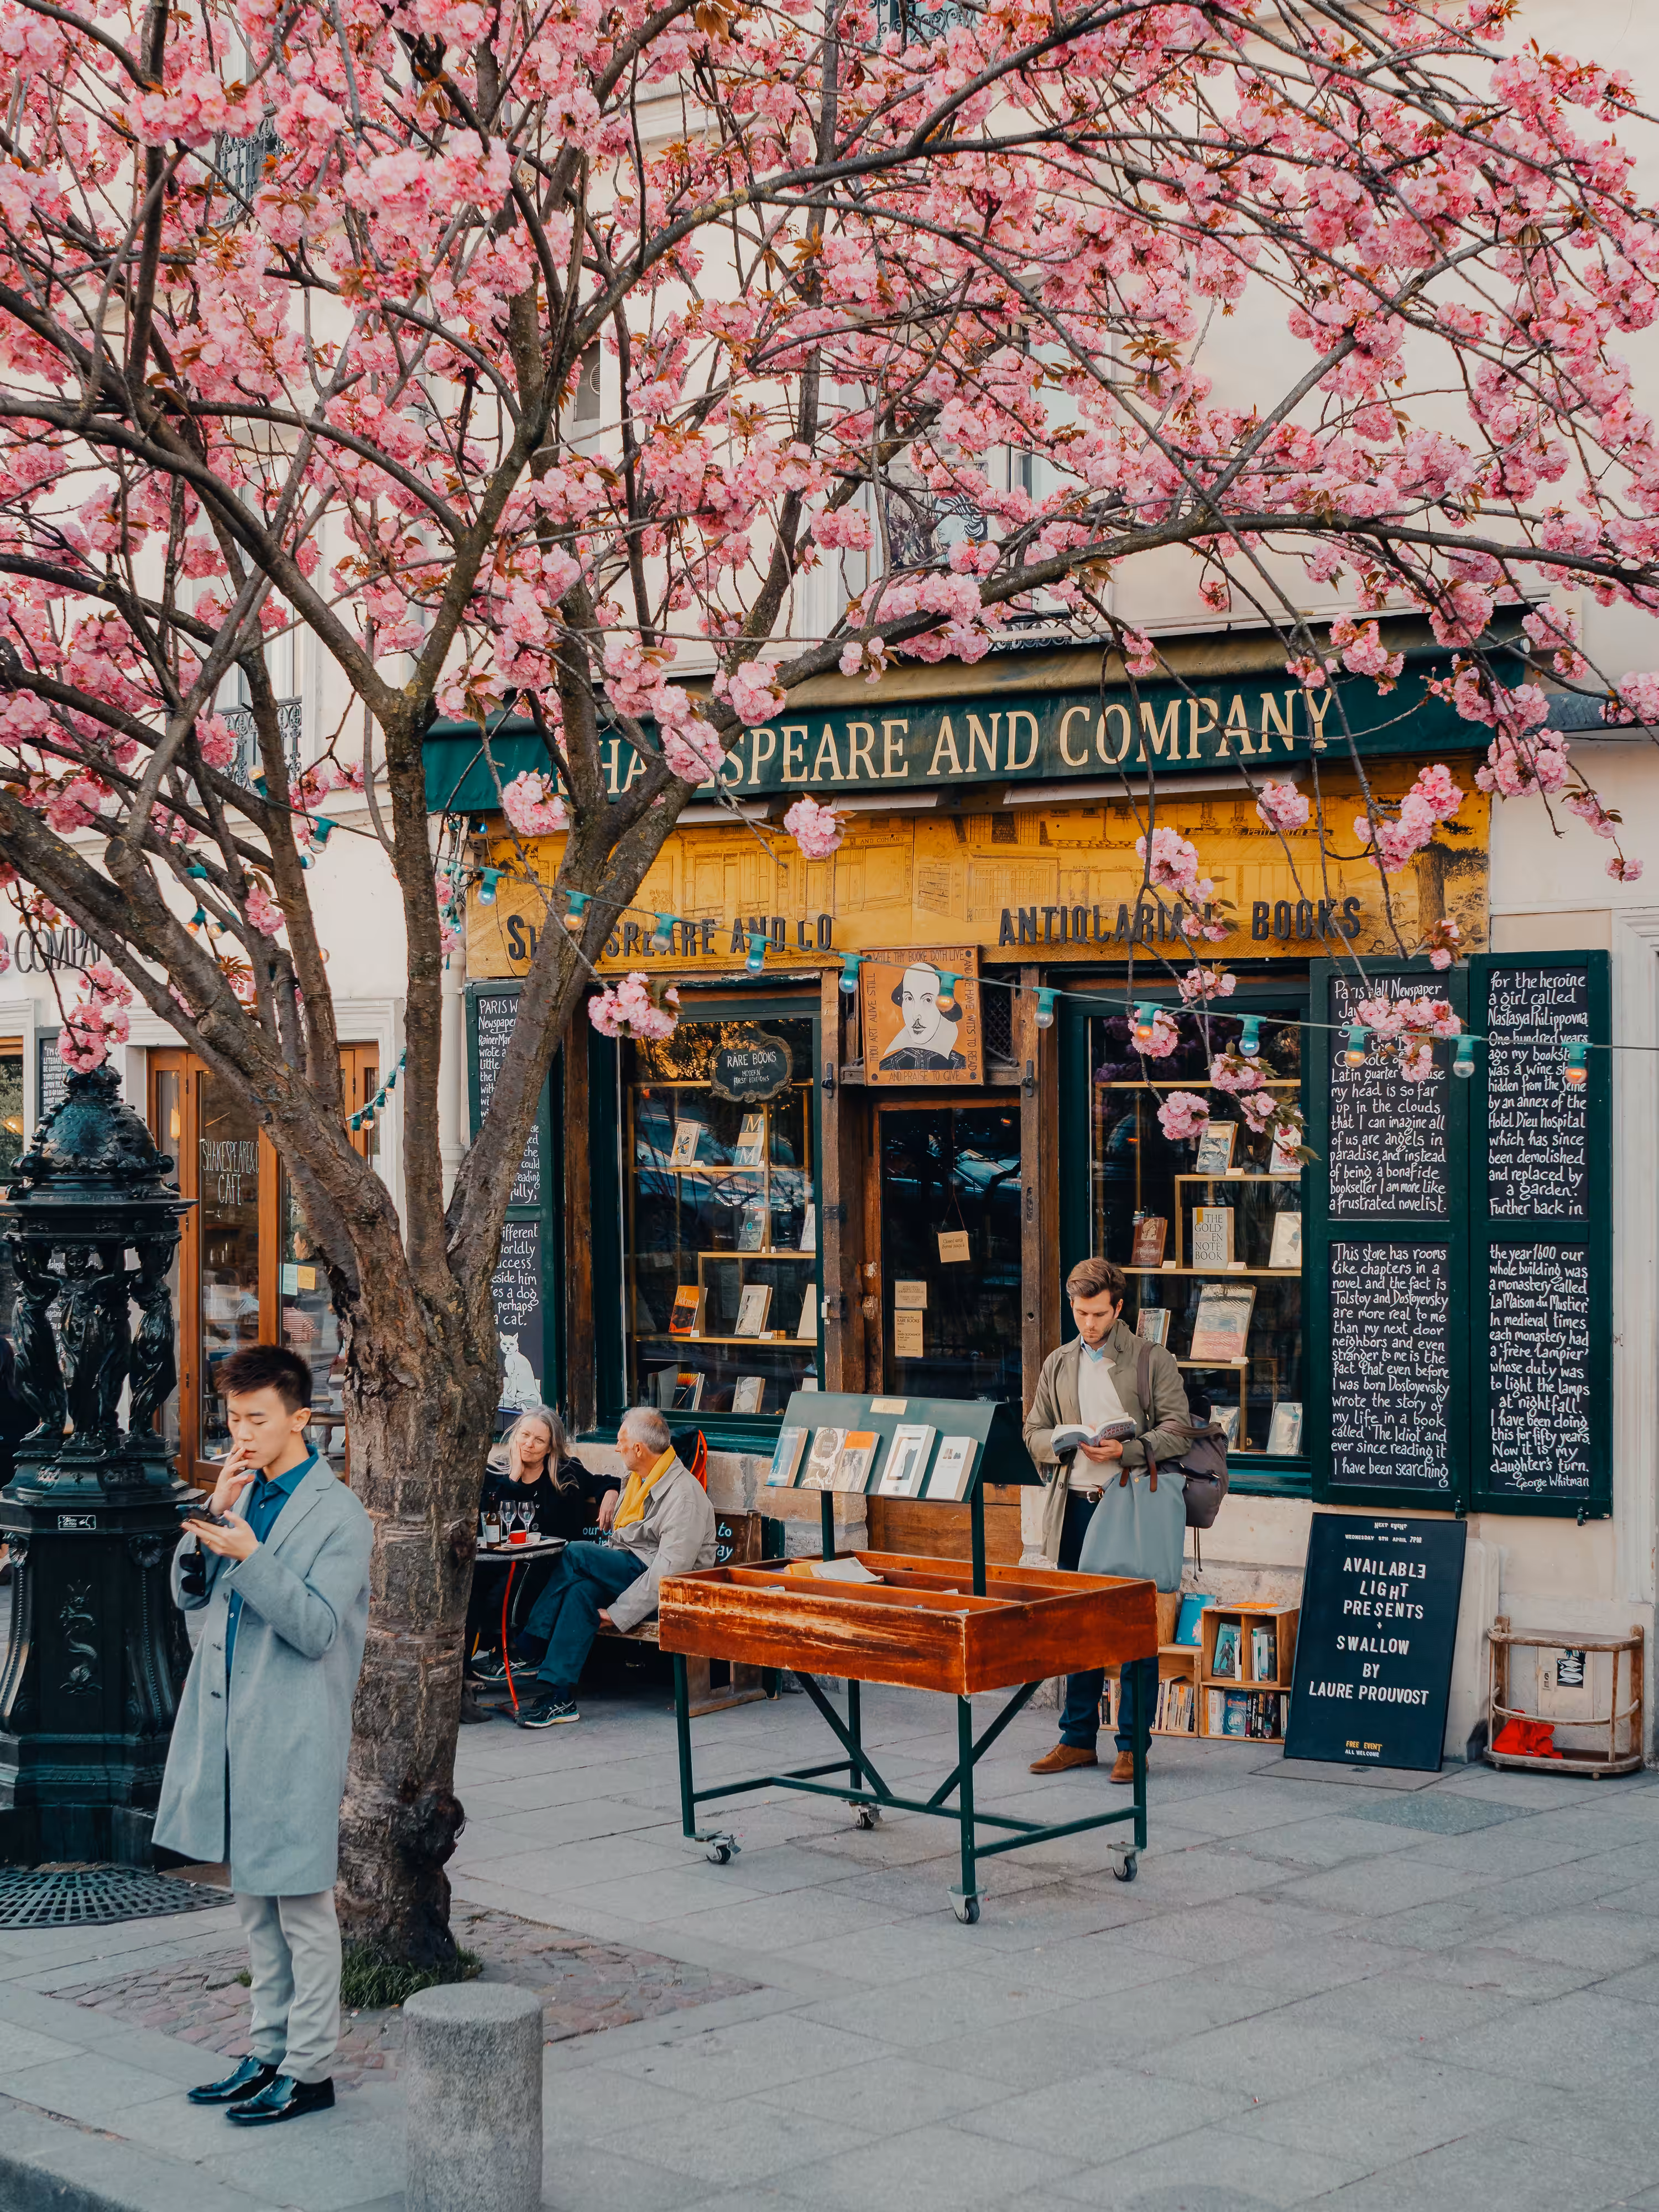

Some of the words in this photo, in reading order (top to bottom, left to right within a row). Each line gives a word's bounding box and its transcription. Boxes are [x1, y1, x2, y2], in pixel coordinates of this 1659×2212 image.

[927, 710, 1040, 776] AND
[1059, 687, 1333, 768] COMPANY
[1251, 896, 1361, 941] BOOKS
[730, 916, 786, 953] AND
[873, 952, 891, 963] WHILE
[894, 952, 906, 963] THY
[909, 951, 927, 962] BOOKE
[931, 950, 947, 961] DOTH
[950, 950, 964, 961] LIVE
[964, 959, 973, 974] AND
[867, 973, 876, 996] STILL
[1491, 971, 1510, 990] for
[1515, 972, 1537, 989] the
[1540, 971, 1586, 988] heroine
[1391, 978, 1442, 1002] Newspaper
[479, 999, 507, 1014] PARIS
[965, 990, 974, 1010] HAVE
[1489, 993, 1496, 1005] a
[1500, 989, 1528, 1011] girl
[1531, 988, 1577, 1004] called
[868, 1000, 877, 1022] ALIVE
[1488, 1005, 1530, 1031] Nastasya
[966, 1015, 976, 1035] WITS
[478, 1034, 499, 1046] Rainer
[869, 1027, 878, 1043] ART
[967, 1039, 977, 1047] TO
[479, 1046, 500, 1057] wrote
[727, 1054, 748, 1067] RARE
[753, 1051, 776, 1065] BOOKS
[870, 1046, 878, 1062] THOU
[967, 1051, 977, 1071] READ
[480, 1071, 492, 1081] the
[734, 1077, 746, 1086] FIRST
[889, 1072, 901, 1081] AND
[904, 1071, 928, 1081] PRAISE
[931, 1071, 940, 1081] TO
[943, 1071, 960, 1081] GIVE
[1332, 1087, 1348, 1103] my
[1352, 1082, 1383, 1098] head
[1387, 1084, 1396, 1097] is
[1400, 1086, 1414, 1097] so
[1417, 1081, 1438, 1100] far
[1336, 1104, 1349, 1118] up
[1357, 1101, 1368, 1114] in
[1373, 1099, 1392, 1113] the
[1397, 1099, 1441, 1114] clouds
[744, 1115, 764, 1132] M
[203, 1141, 250, 1173] SHAKESPEARE
[521, 1157, 540, 1169] could
[1489, 1149, 1513, 1164] been
[1517, 1147, 1585, 1165] demolished
[1329, 1199, 1335, 1211] a
[1338, 1193, 1396, 1214] frustrated
[1399, 1194, 1446, 1213] novelist.
[1489, 1198, 1531, 1215] Further
[1534, 1198, 1564, 1214] back
[1569, 1199, 1583, 1215] in
[1205, 1214, 1223, 1223] THE
[502, 1223, 539, 1241] ifferent
[1212, 1233, 1223, 1241] EN
[1195, 1251, 1223, 1260] BOOK
[1332, 1243, 1359, 1261] This
[1363, 1244, 1387, 1261] store
[1390, 1244, 1409, 1260] has
[1413, 1249, 1447, 1260] rooms
[1490, 1244, 1507, 1259] the
[1509, 1249, 1532, 1265] year
[1533, 1244, 1556, 1260] 1600
[1561, 1251, 1584, 1261] our
[492, 1270, 517, 1284] eside
[518, 1270, 537, 1285] him
[1332, 1260, 1358, 1275] like
[1360, 1261, 1412, 1280] chapters
[1416, 1261, 1425, 1274] in
[1432, 1264, 1439, 1275] a
[507, 1287, 513, 1298] a
[517, 1286, 539, 1306] dog
[498, 1299, 532, 1315] perhaps
[503, 1312, 527, 1326] cat.
[1493, 1442, 1519, 1457] Now
[1522, 1441, 1533, 1455] it
[1537, 1442, 1548, 1455] is
[1556, 1448, 1579, 1463] my
[1334, 1458, 1337, 1475] I
[1342, 1457, 1366, 1474] have
[1369, 1457, 1392, 1475] been
[1396, 1460, 1449, 1488] searching
[1490, 1456, 1553, 1479] daughter's
[1558, 1458, 1589, 1473] turn.
[1549, 1473, 1589, 1487] Whitman
[718, 1521, 733, 1537] to
[1343, 1557, 1426, 1579] AVAILABLE
[1359, 1580, 1409, 1600] LIGHT
[1343, 1600, 1424, 1619] PRESENTS
[1336, 1635, 1410, 1655] SWALLOW
[1362, 1663, 1380, 1678] BY
[1309, 1681, 1354, 1699] LAURE
[1358, 1685, 1430, 1705] PROUVOST
[1364, 1742, 1383, 1752] EVENT
